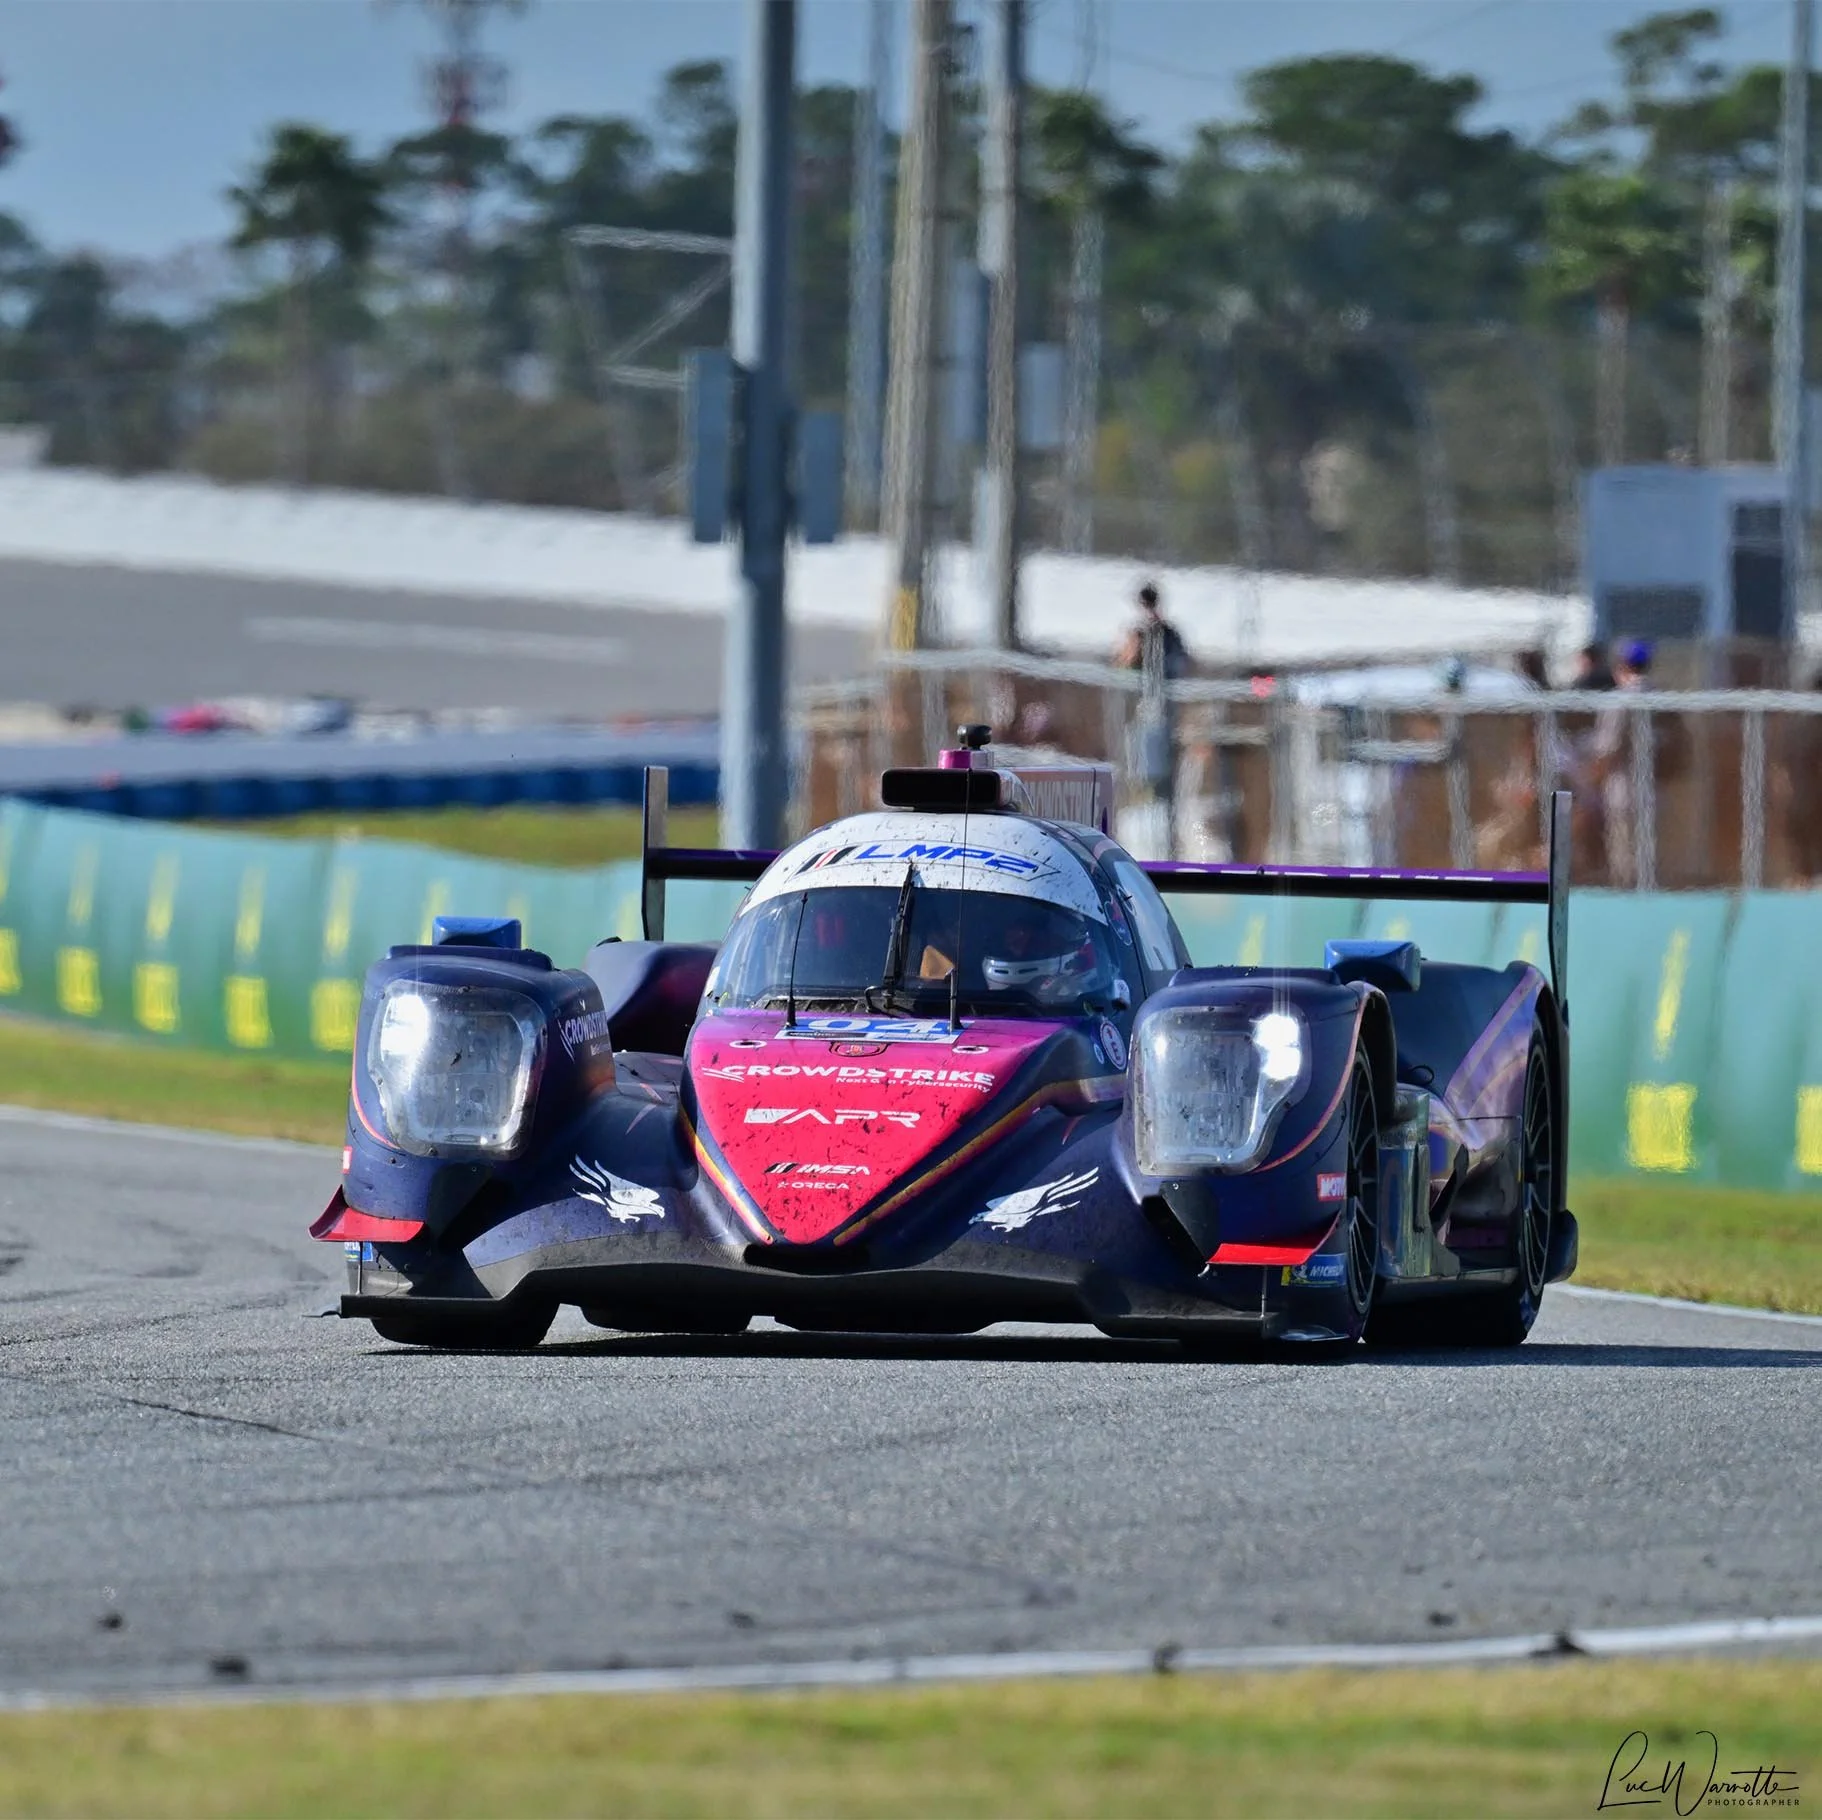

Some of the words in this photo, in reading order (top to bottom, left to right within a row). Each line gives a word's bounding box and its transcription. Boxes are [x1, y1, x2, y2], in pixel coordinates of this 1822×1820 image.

[855, 844, 1038, 874] LMP2
[808, 1018, 943, 1033] 04
[721, 1065, 996, 1087] CROWDSTRIKE
[835, 1076, 868, 1084] Next
[870, 1077, 896, 1086] Gn
[782, 1108, 921, 1129] APR
[796, 1163, 871, 1176] IMSA
[1320, 1176, 1345, 1197] MOT
